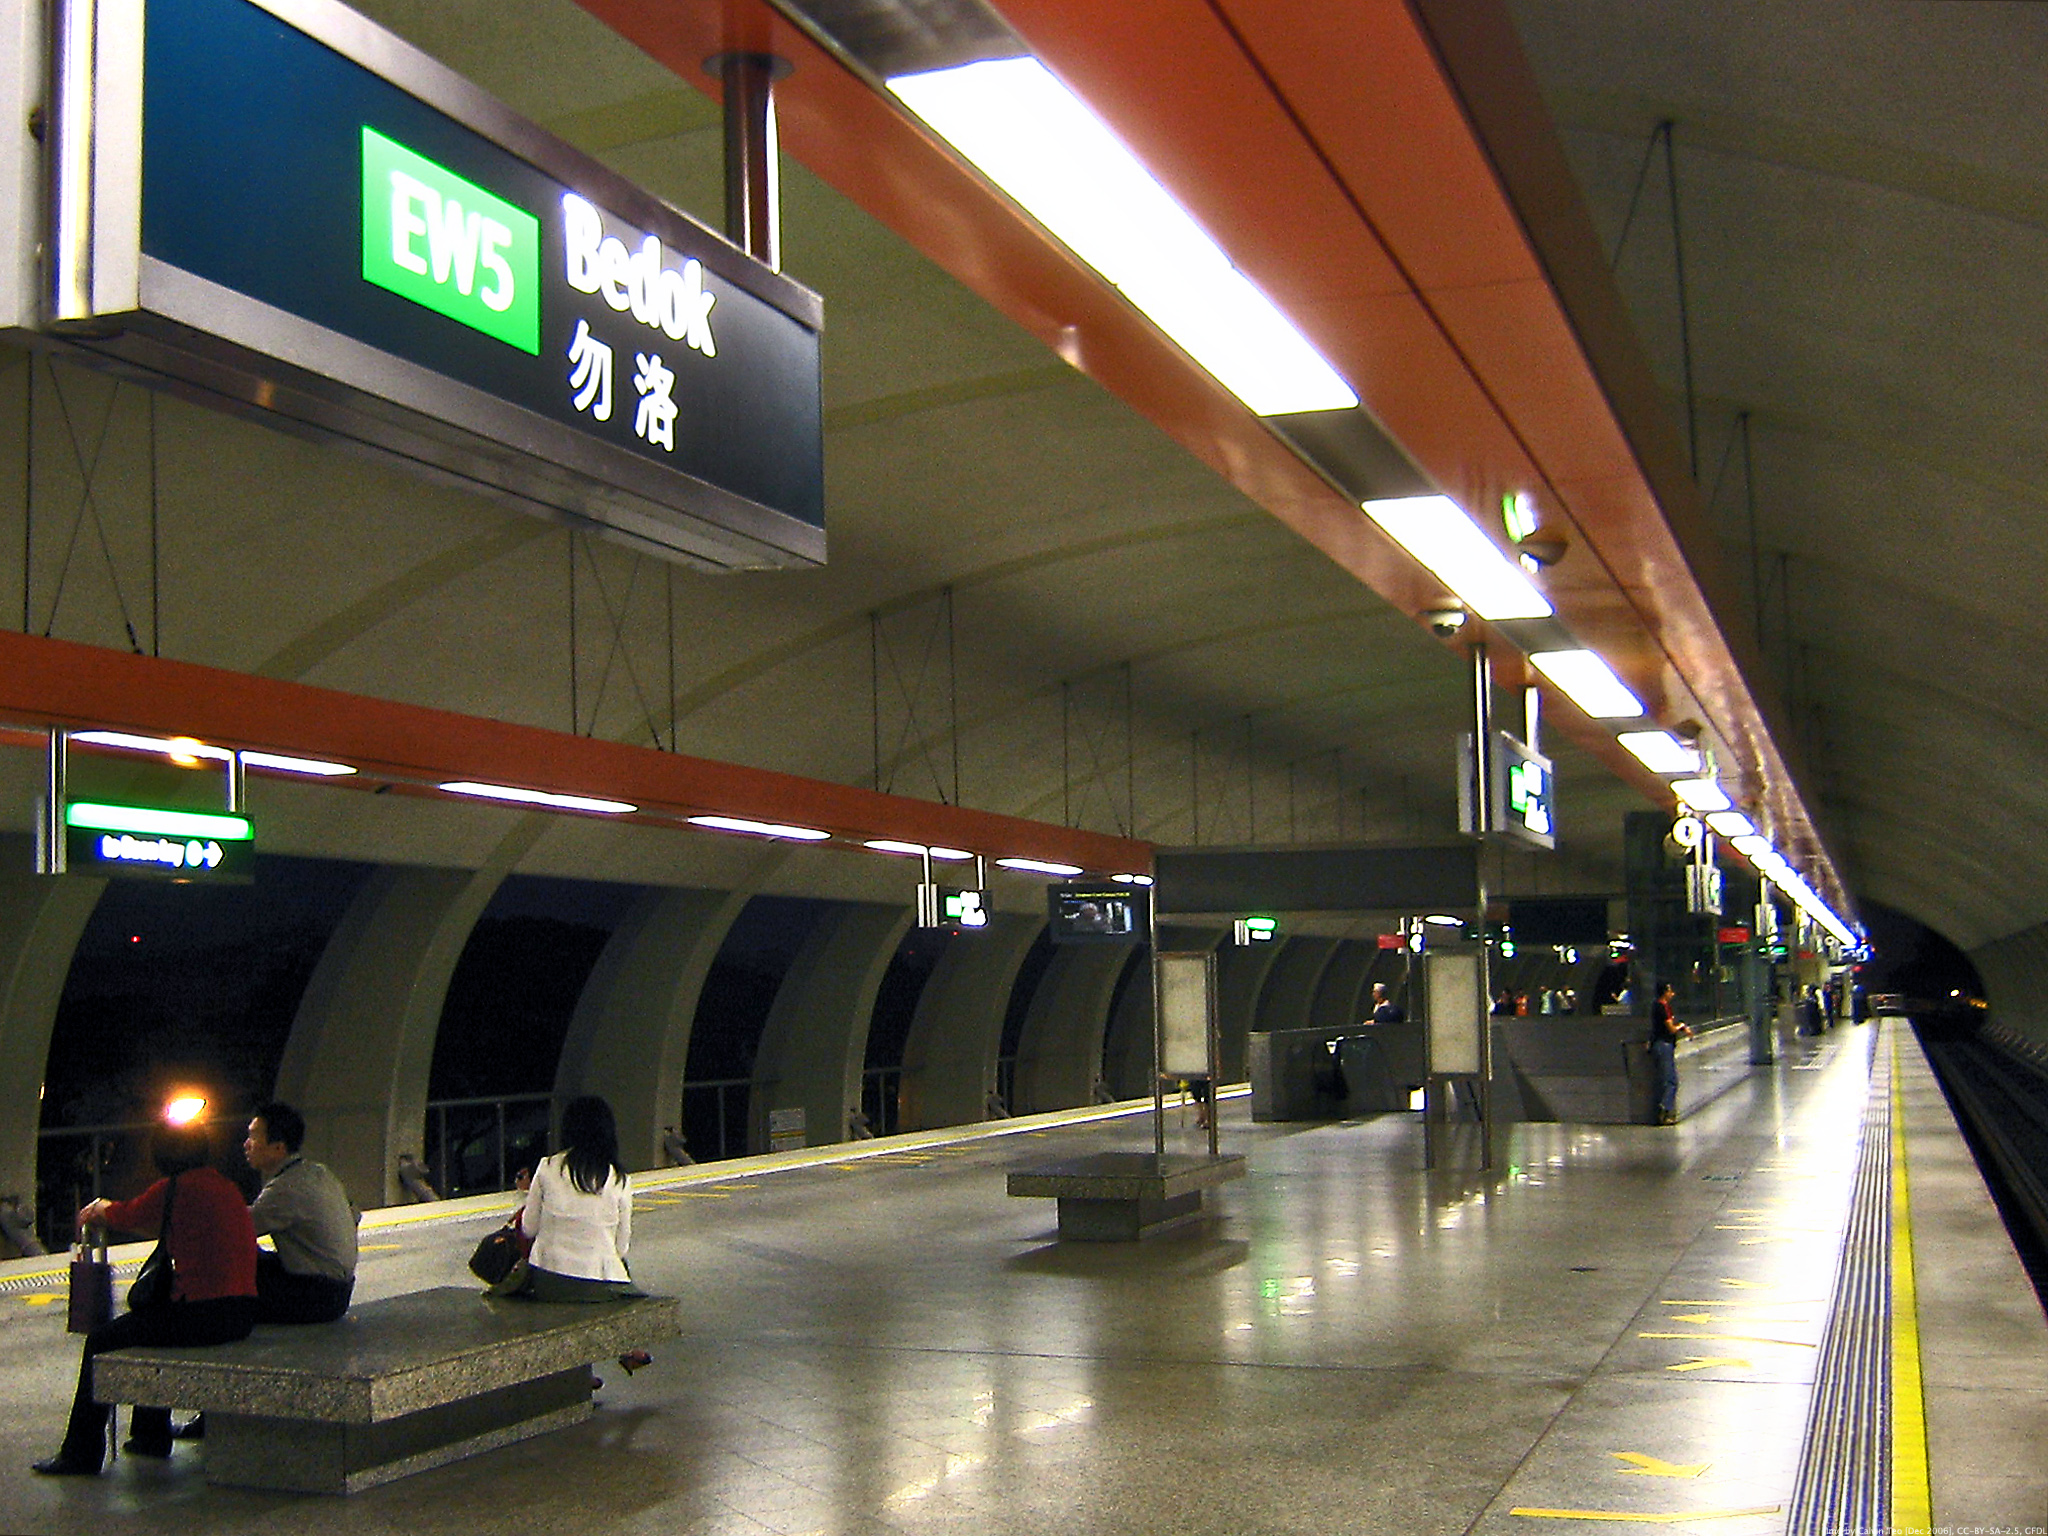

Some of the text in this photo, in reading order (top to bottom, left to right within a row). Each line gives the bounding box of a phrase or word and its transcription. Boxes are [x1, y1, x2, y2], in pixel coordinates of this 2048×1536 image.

[390, 170, 515, 312] EW5
[561, 193, 718, 358] Bedok
[568, 320, 679, 452] 勿洛
